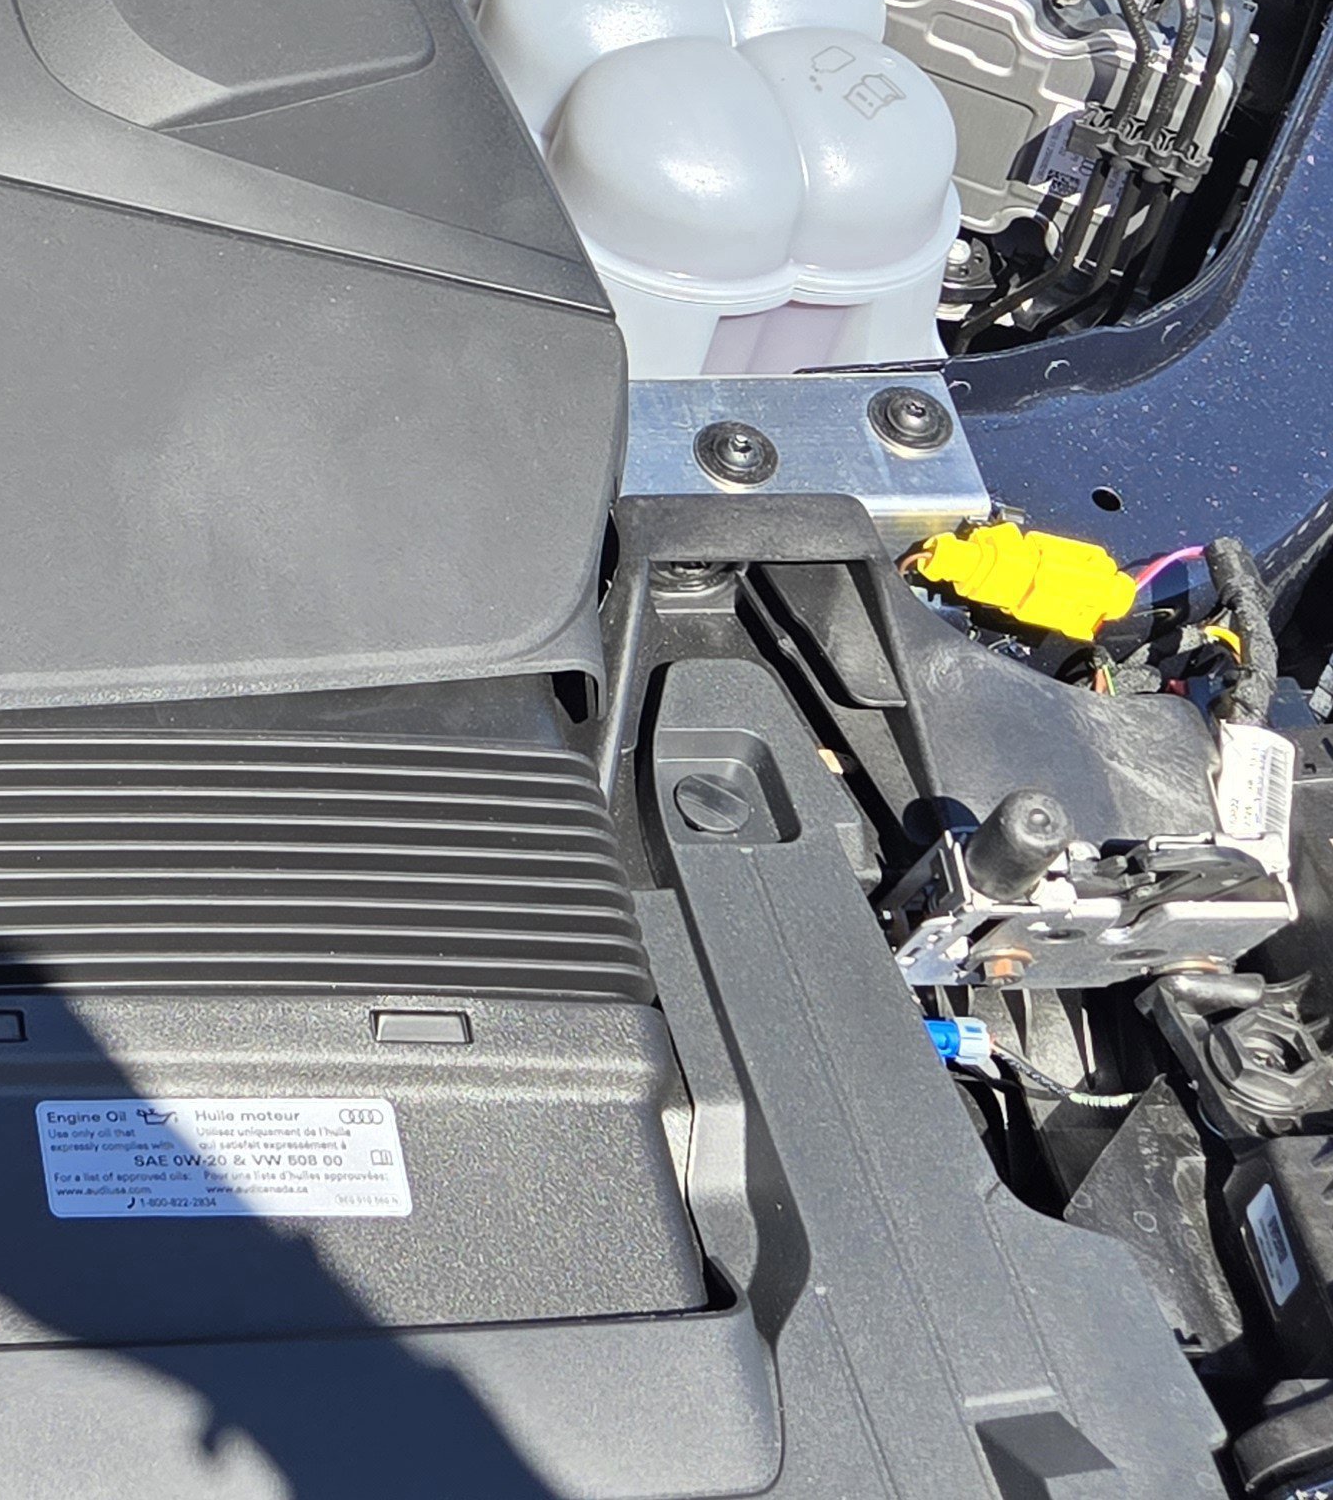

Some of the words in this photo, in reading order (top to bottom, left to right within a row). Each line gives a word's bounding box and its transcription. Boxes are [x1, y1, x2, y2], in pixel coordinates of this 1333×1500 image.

[46, 1111, 101, 1125] Engine
[105, 1110, 127, 1122] Oil
[194, 1109, 234, 1121] Huile
[239, 1111, 300, 1121] moteur
[47, 1129, 68, 1138] Use
[71, 1129, 95, 1139] only
[97, 1127, 110, 1136] oil
[113, 1127, 135, 1136] that
[237, 1127, 300, 1137] uniquement
[303, 1127, 316, 1136] de
[49, 1142, 99, 1152] expressly
[100, 1141, 148, 1151] complies
[150, 1140, 174, 1149] with
[198, 1141, 216, 1150] qui
[219, 1141, 260, 1149] satisfait
[263, 1140, 337, 1150] expressément
[133, 1154, 168, 1167] SAE
[172, 1154, 227, 1166] 0W-20
[232, 1155, 246, 1166] &
[252, 1154, 282, 1166] VW
[287, 1154, 317, 1166] 508
[322, 1154, 343, 1166] 00
[53, 1172, 72, 1182] For
[82, 1171, 99, 1181] list
[101, 1171, 114, 1181] of
[116, 1171, 166, 1183] approved
[203, 1170, 227, 1181] Pour
[231, 1172, 251, 1180] une
[253, 1171, 275, 1180] liste
[55, 1185, 151, 1195] www.audiusa.com
[205, 1185, 308, 1193] www.audicanada.ca
